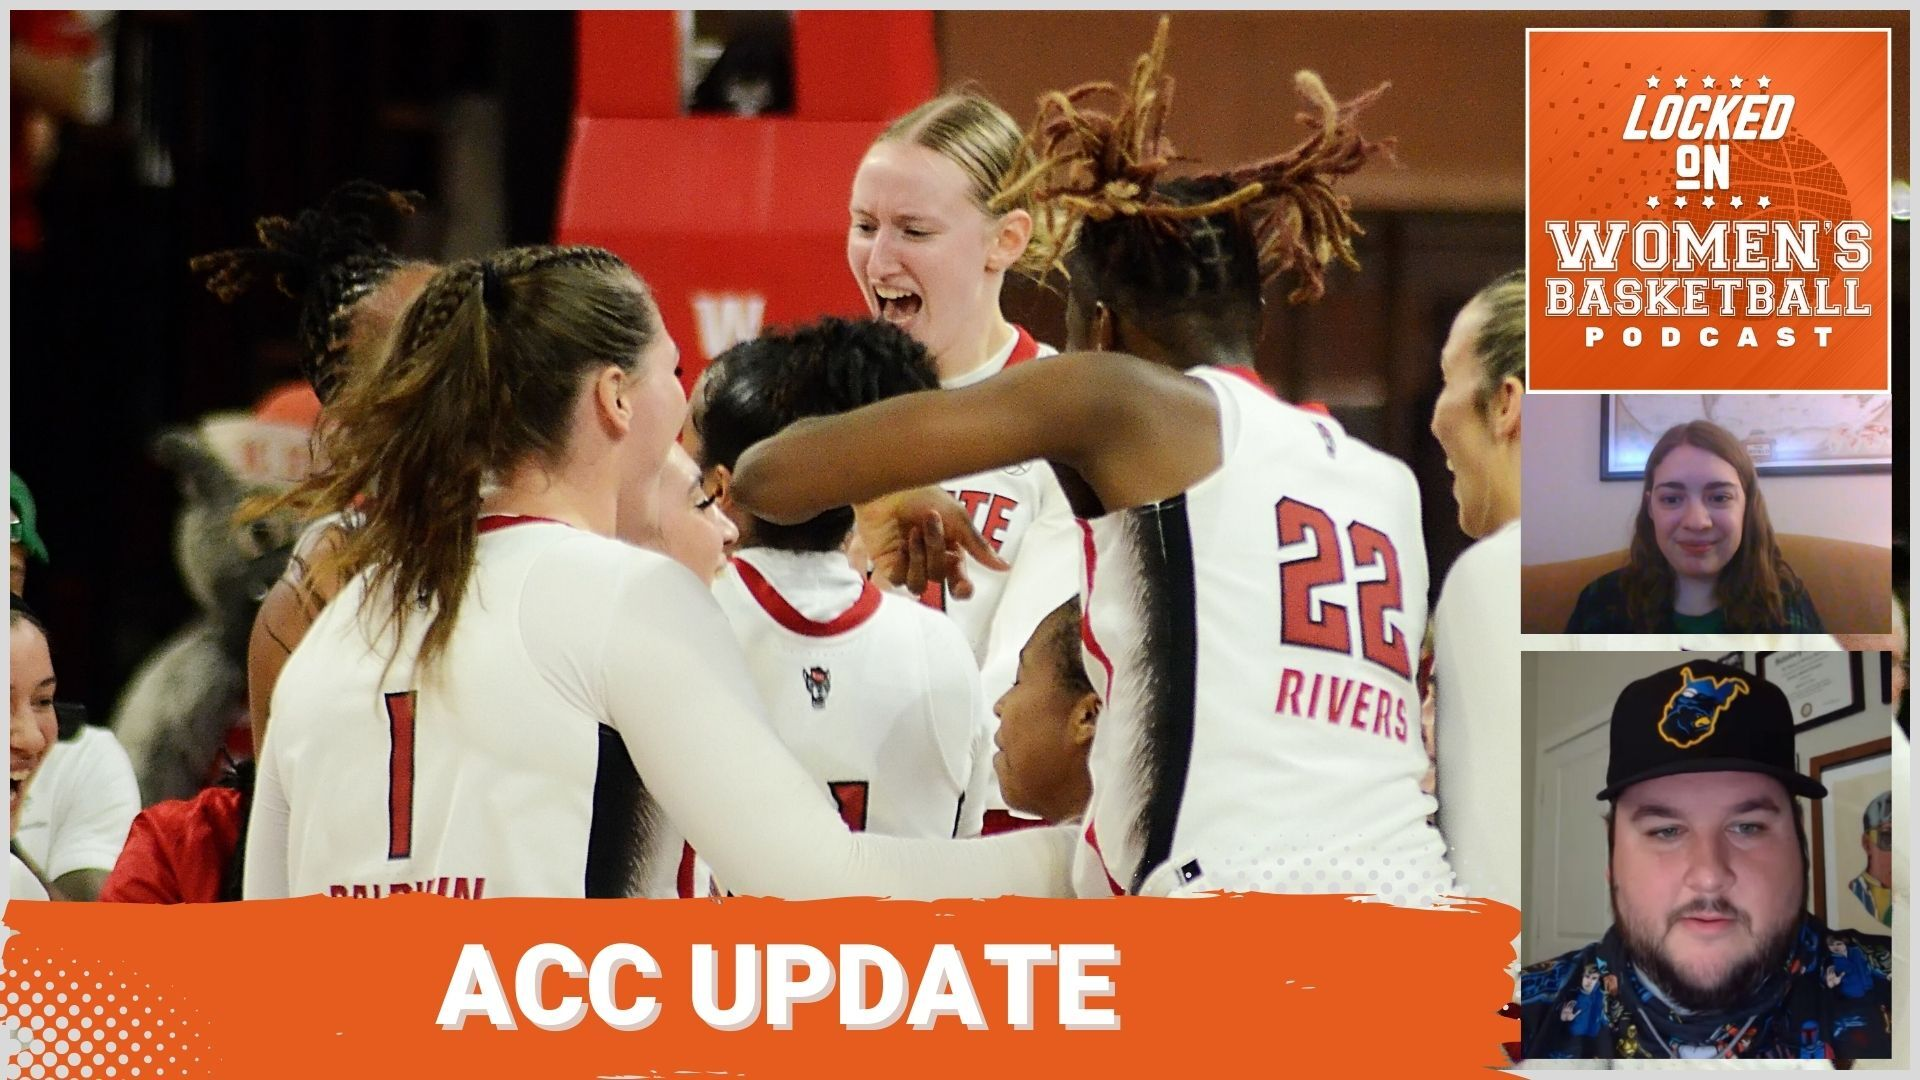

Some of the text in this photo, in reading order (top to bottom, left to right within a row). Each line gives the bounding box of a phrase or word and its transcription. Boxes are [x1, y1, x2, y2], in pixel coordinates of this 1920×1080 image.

[1275, 496, 1413, 681] 22
[384, 690, 418, 860] 1
[1275, 668, 1409, 744] RIVERS
